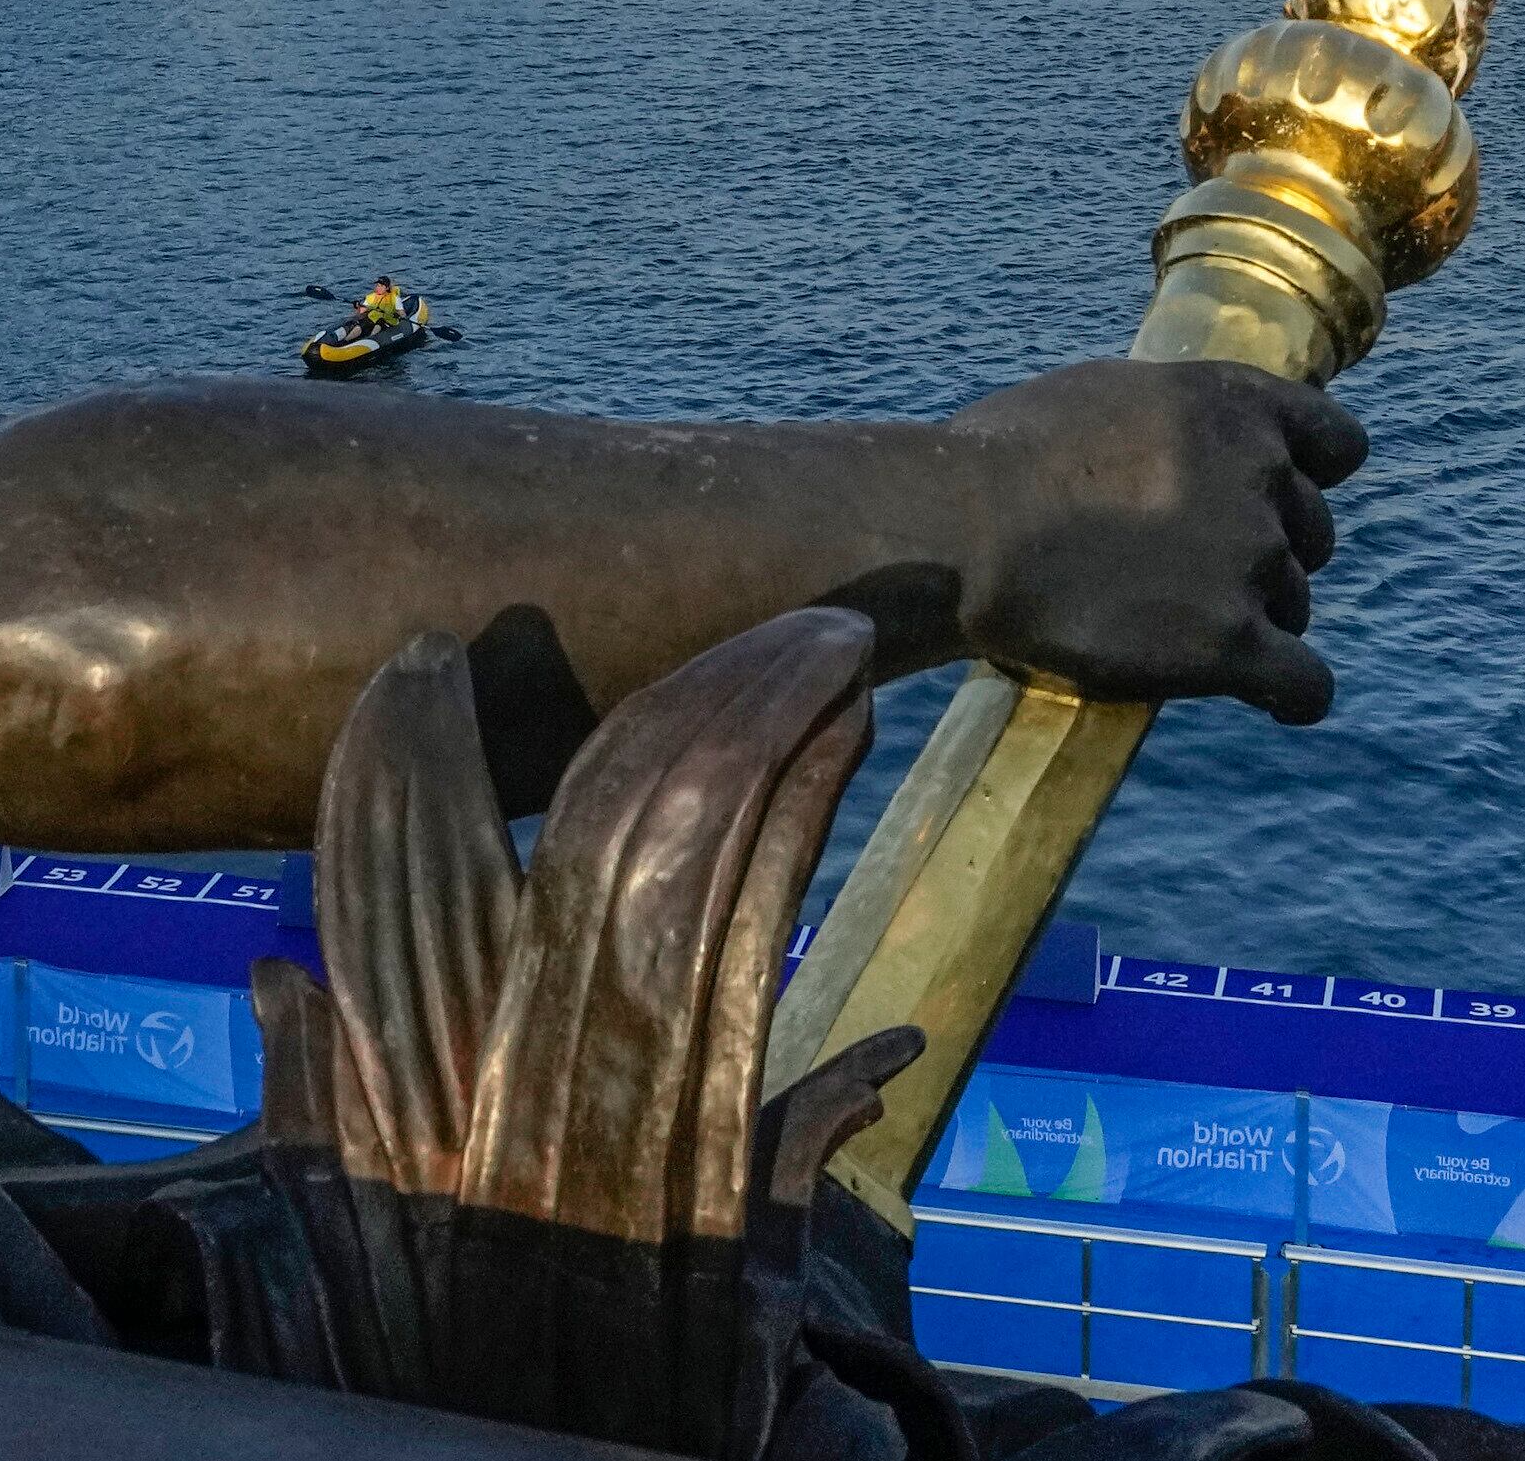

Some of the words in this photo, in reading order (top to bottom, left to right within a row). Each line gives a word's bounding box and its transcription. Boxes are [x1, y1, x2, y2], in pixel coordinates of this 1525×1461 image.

[43, 868, 88, 882] 53
[138, 875, 183, 892] 52
[1143, 971, 1189, 987] 42
[1250, 982, 1294, 998] 41
[1358, 991, 1406, 1008] 40
[1469, 1002, 1516, 1018] 39
